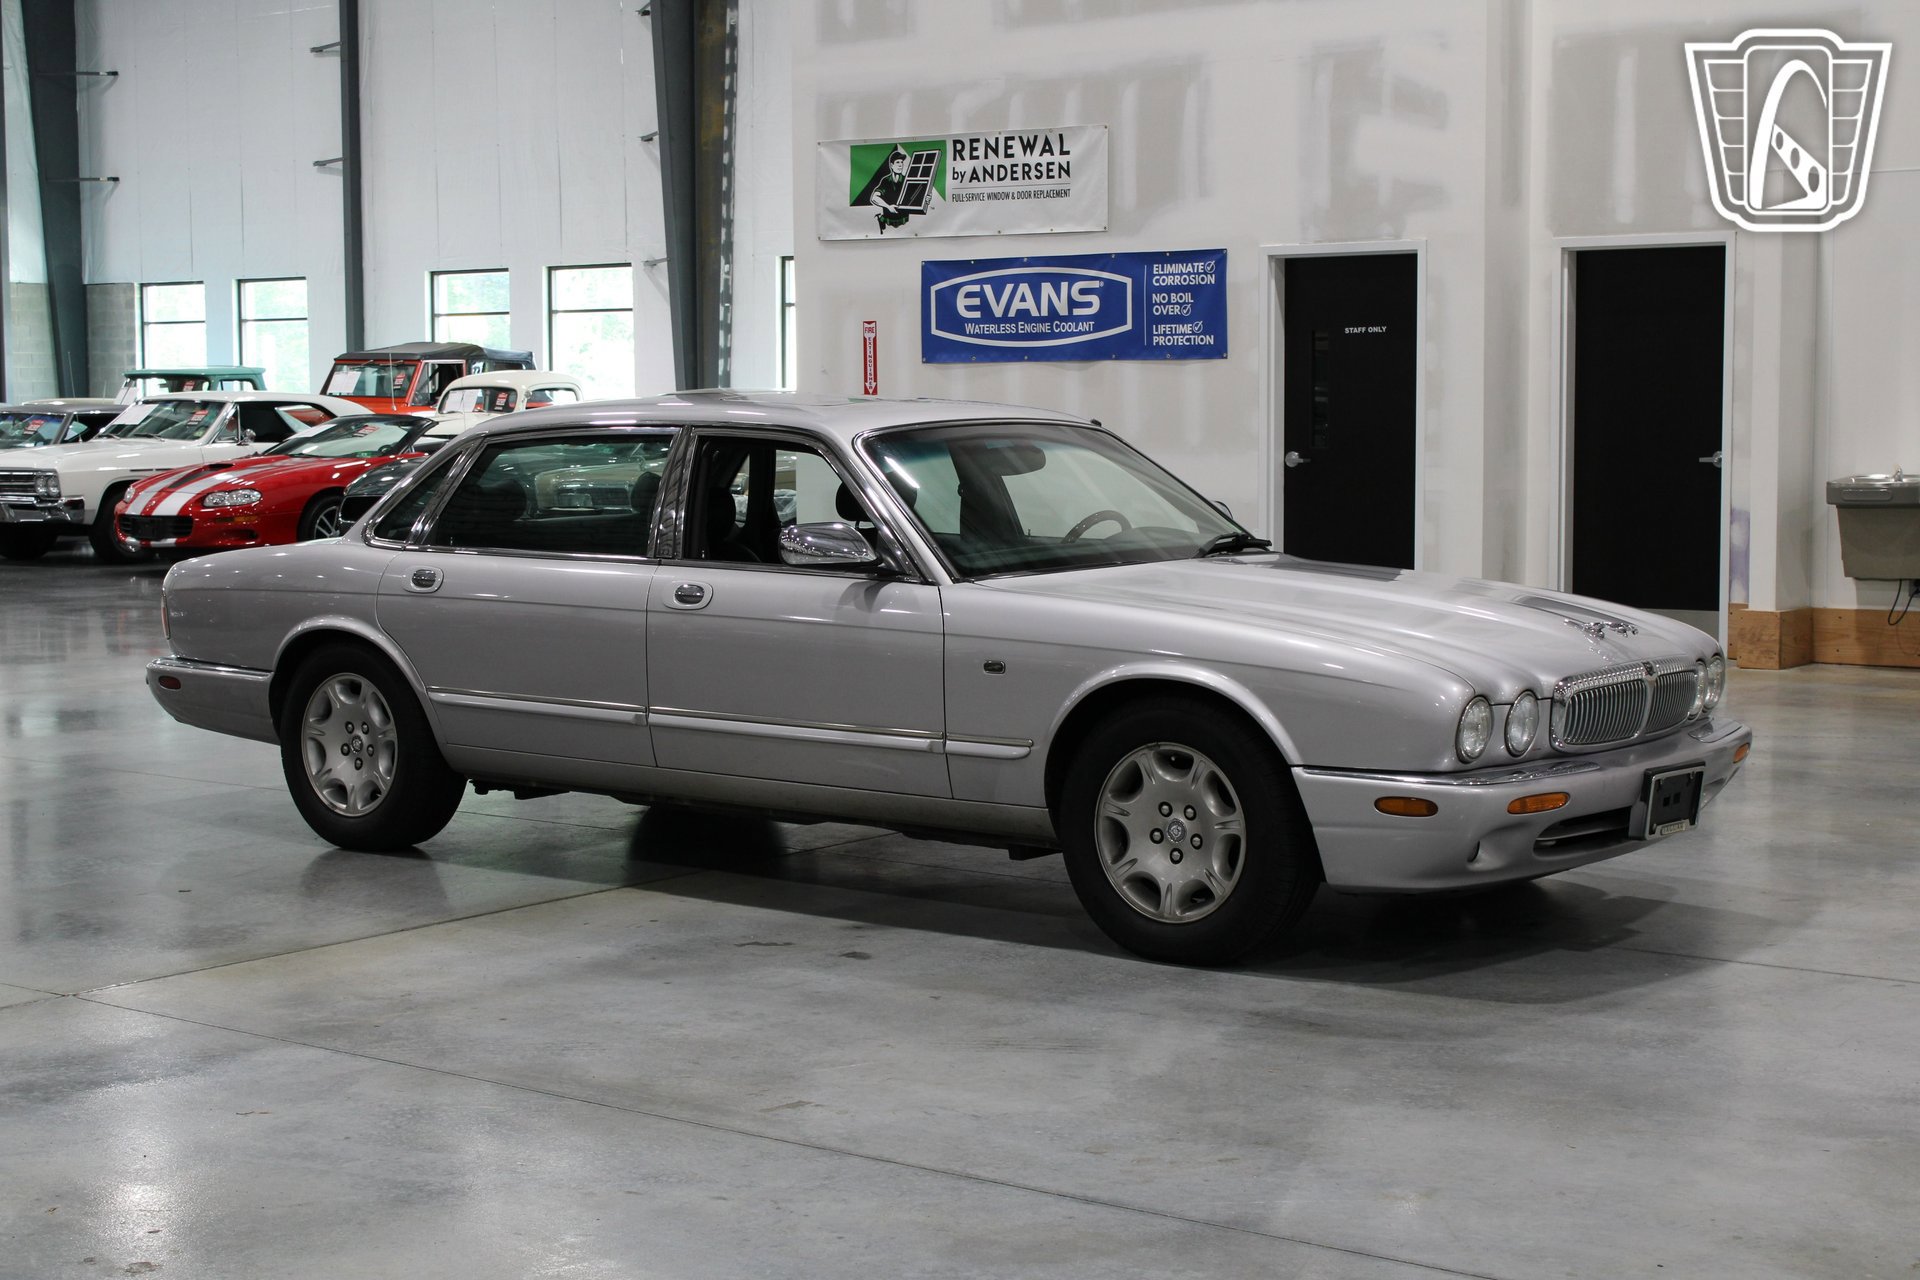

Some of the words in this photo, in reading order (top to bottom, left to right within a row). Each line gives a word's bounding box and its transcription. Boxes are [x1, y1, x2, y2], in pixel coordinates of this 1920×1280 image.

[952, 133, 1071, 161] RENEWAL
[952, 167, 967, 183] by
[968, 161, 1071, 183] ANDERSEN
[952, 192, 985, 202] FULL-SERVICE
[986, 191, 1010, 201] WINDOW
[1011, 191, 1016, 200] &
[1017, 190, 1033, 200] DOOR
[1033, 188, 1071, 199] REPLACEMENT
[1153, 262, 1204, 274] ELIMINATE
[1152, 274, 1216, 286] CORROSION
[1152, 293, 1168, 304] NO
[1170, 292, 1194, 303] BOIL
[1153, 304, 1181, 316] OVER
[864, 326, 875, 334] FIRE
[1152, 324, 1193, 335] LIFETIME
[1152, 334, 1215, 346] PROTECTION
